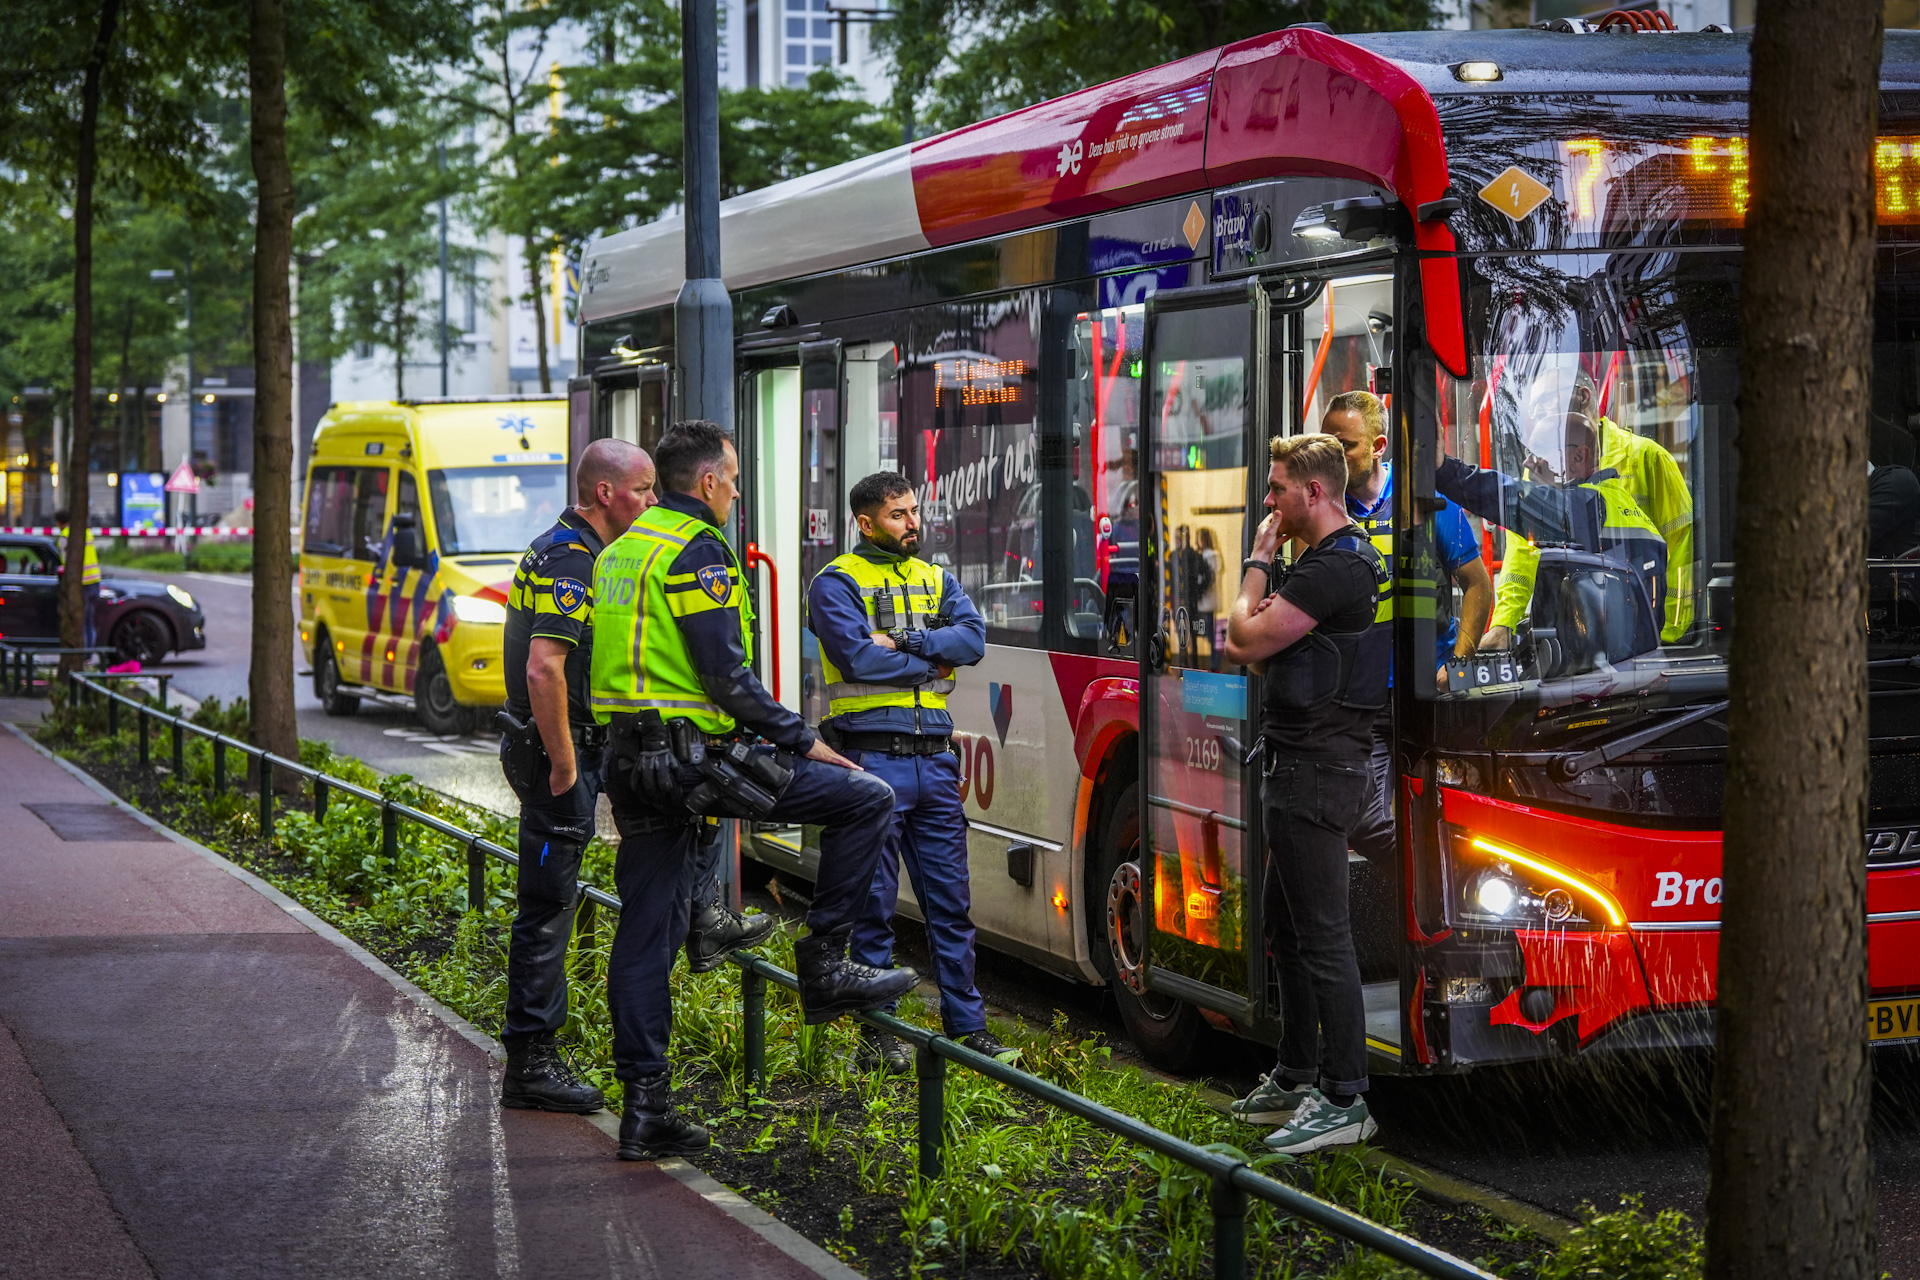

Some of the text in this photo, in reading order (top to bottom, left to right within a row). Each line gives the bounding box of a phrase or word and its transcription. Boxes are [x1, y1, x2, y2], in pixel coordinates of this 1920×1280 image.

[1088, 122, 1184, 158] Deze bus rijdt op groene stroom
[1566, 138, 1602, 217] 7
[1215, 213, 1246, 238] Bravo
[1141, 236, 1176, 255] CITEA
[934, 358, 1025, 408] 7 Eindhoven
[962, 382, 1018, 406] Station
[1003, 432, 1037, 491] ons
[557, 581, 585, 593] POLITIE
[702, 569, 727, 579] POLITIE
[595, 577, 635, 605] OVD
[1187, 736, 1220, 771] 2169
